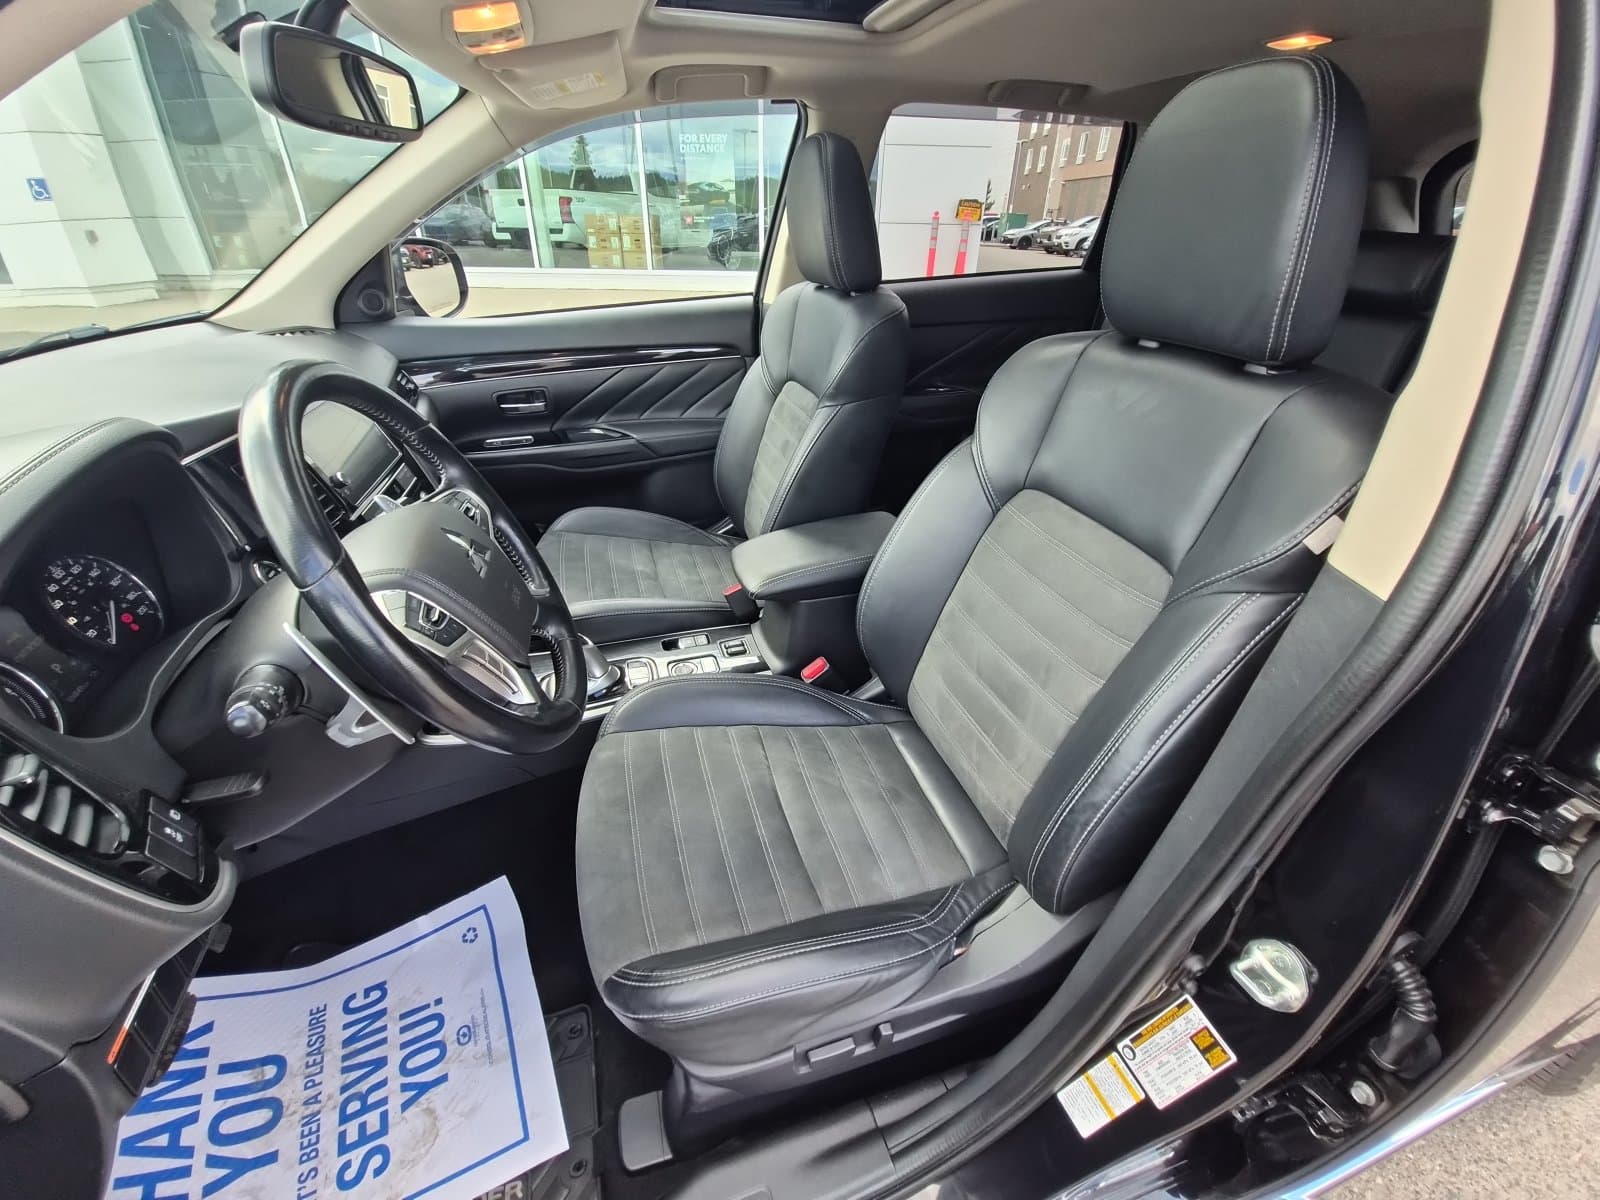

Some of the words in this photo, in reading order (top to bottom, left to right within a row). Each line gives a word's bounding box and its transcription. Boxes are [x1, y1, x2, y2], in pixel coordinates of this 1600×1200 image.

[679, 133, 698, 143] FOR
[700, 133, 727, 143] EVERY
[680, 143, 725, 153] DISTANCE
[303, 1003, 327, 1091] PLEASURE
[399, 997, 448, 1114] YOU!
[112, 1020, 215, 1200] HAN
[302, 1091, 322, 1107] A
[336, 980, 391, 1191] SERVING
[202, 1054, 288, 1199] YOU
[299, 1109, 321, 1165] BEEN
[297, 1167, 318, 1200] T'S
